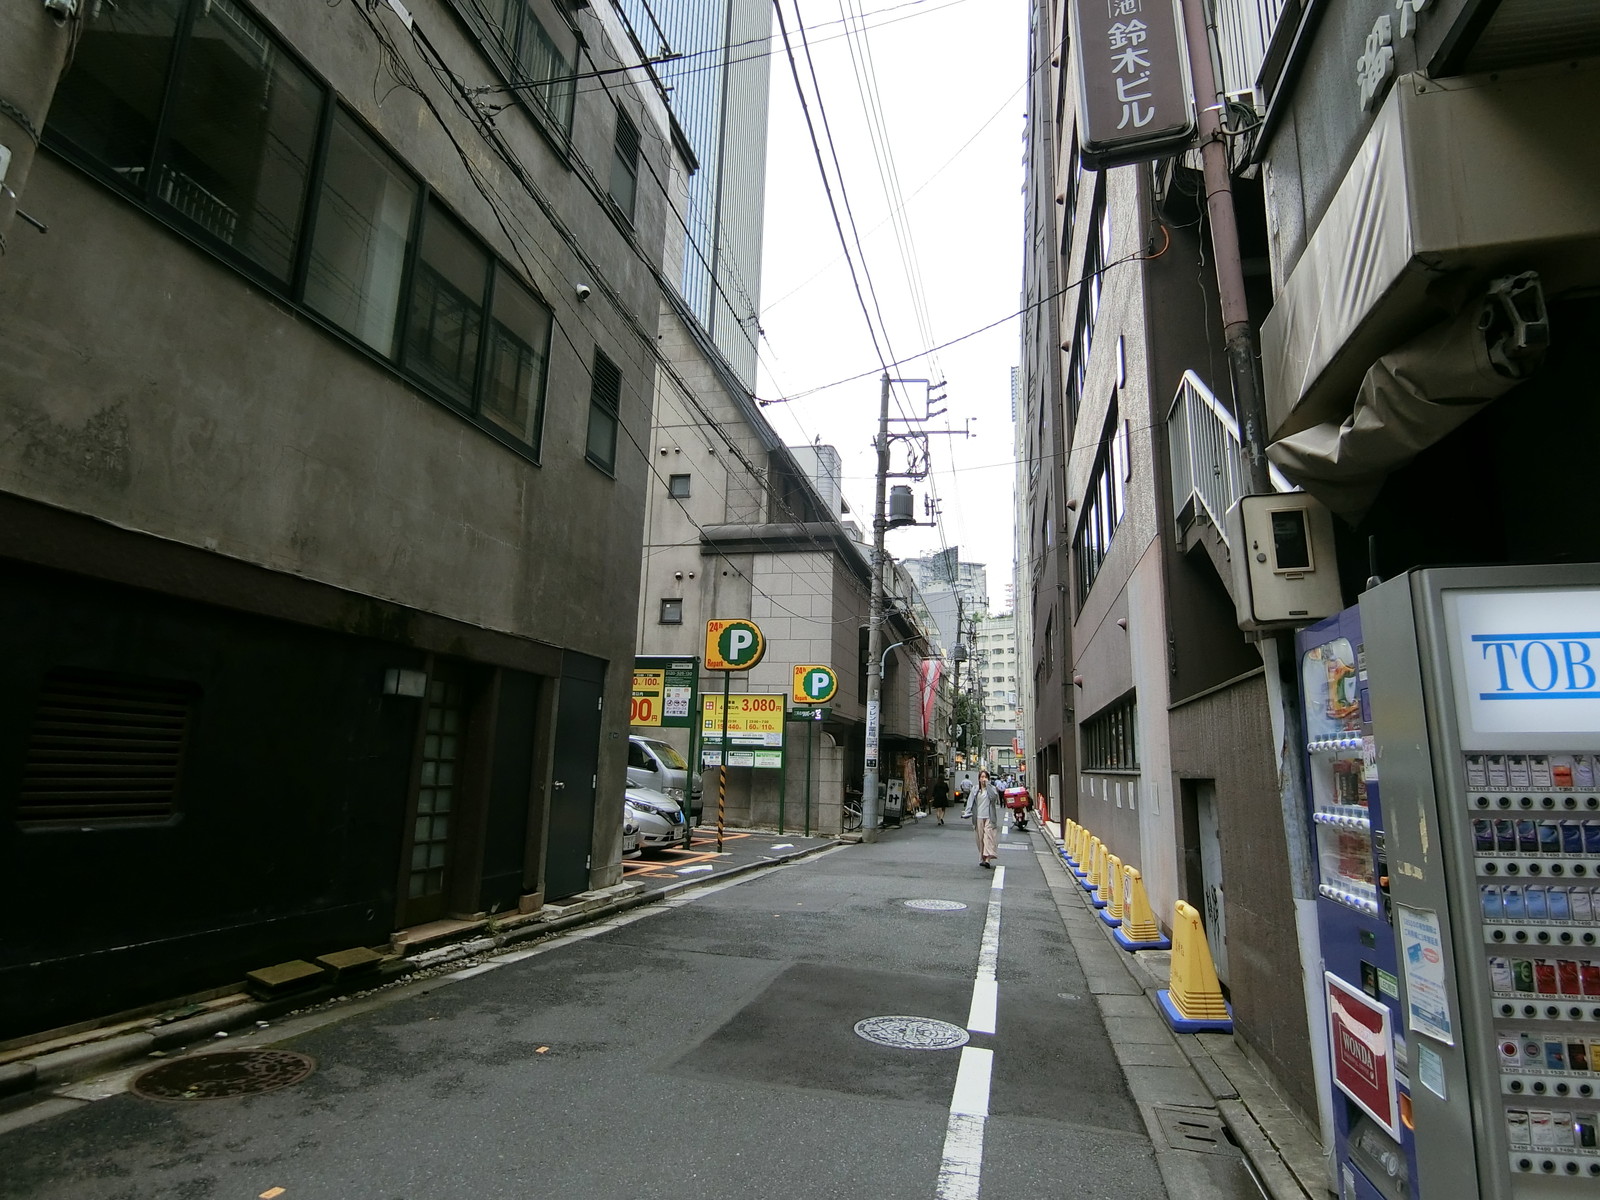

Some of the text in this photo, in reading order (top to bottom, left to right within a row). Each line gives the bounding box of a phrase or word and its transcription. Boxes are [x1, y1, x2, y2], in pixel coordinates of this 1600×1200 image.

[1107, 19, 1155, 130] 鈴木ビル
[708, 621, 724, 633] 24h
[729, 629, 753, 660] P
[707, 658, 724, 668] Repark
[1482, 640, 1597, 692] TOB
[811, 673, 830, 696] P
[741, 698, 782, 712] 3,080円
[1342, 1030, 1374, 1071] WONDA
